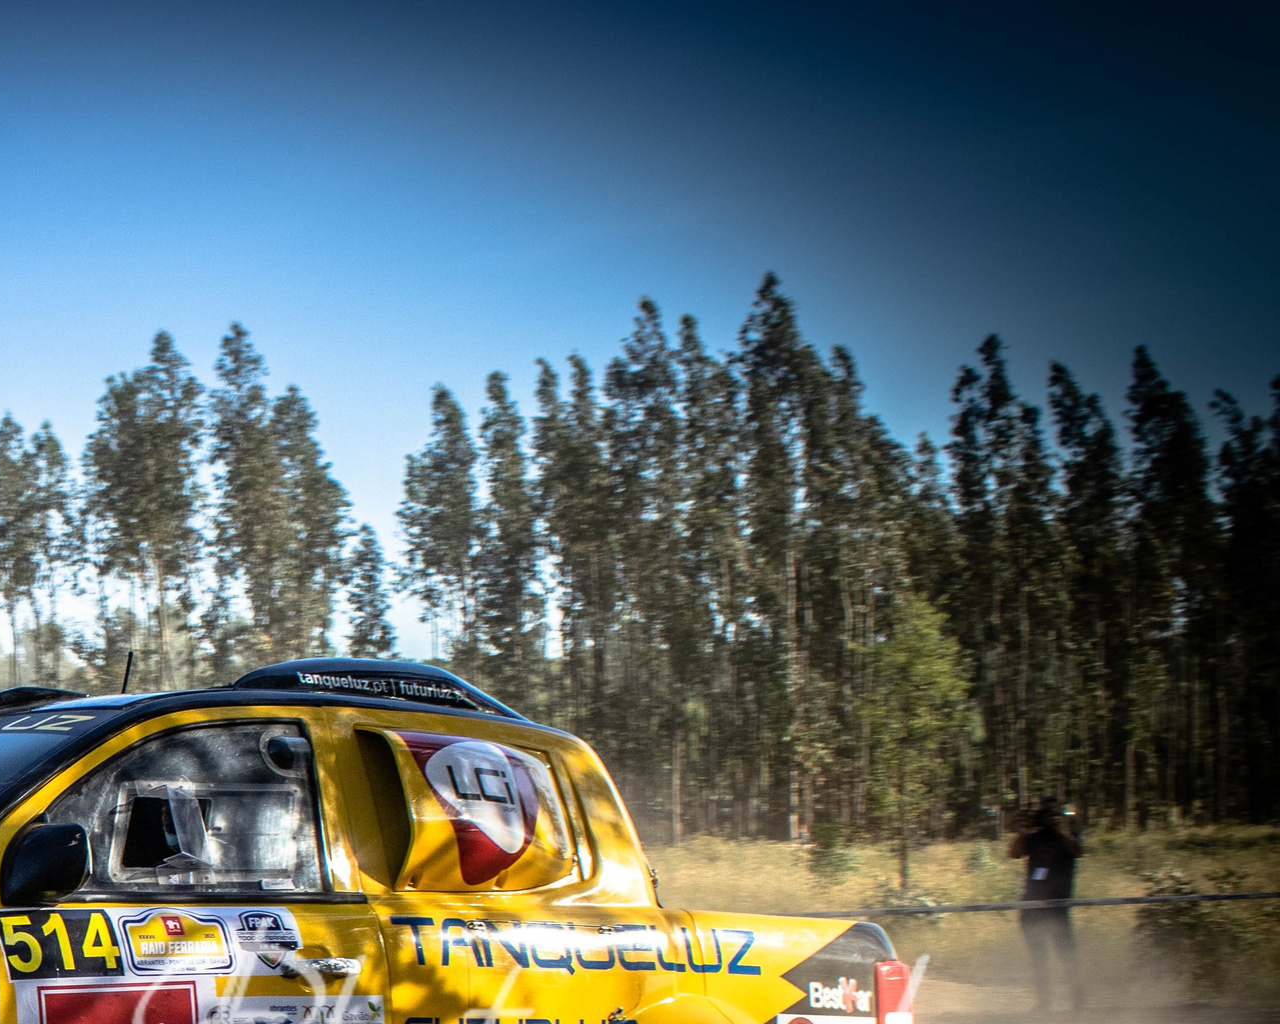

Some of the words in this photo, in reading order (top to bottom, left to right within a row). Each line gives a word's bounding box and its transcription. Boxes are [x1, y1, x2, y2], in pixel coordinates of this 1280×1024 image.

[296, 671, 389, 693] tanqueluz.pt
[0, 912, 120, 974] 514
[140, 941, 166, 956] RAID
[168, 940, 219, 955] FERRARIA
[389, 915, 762, 976] TANQUELUZ
